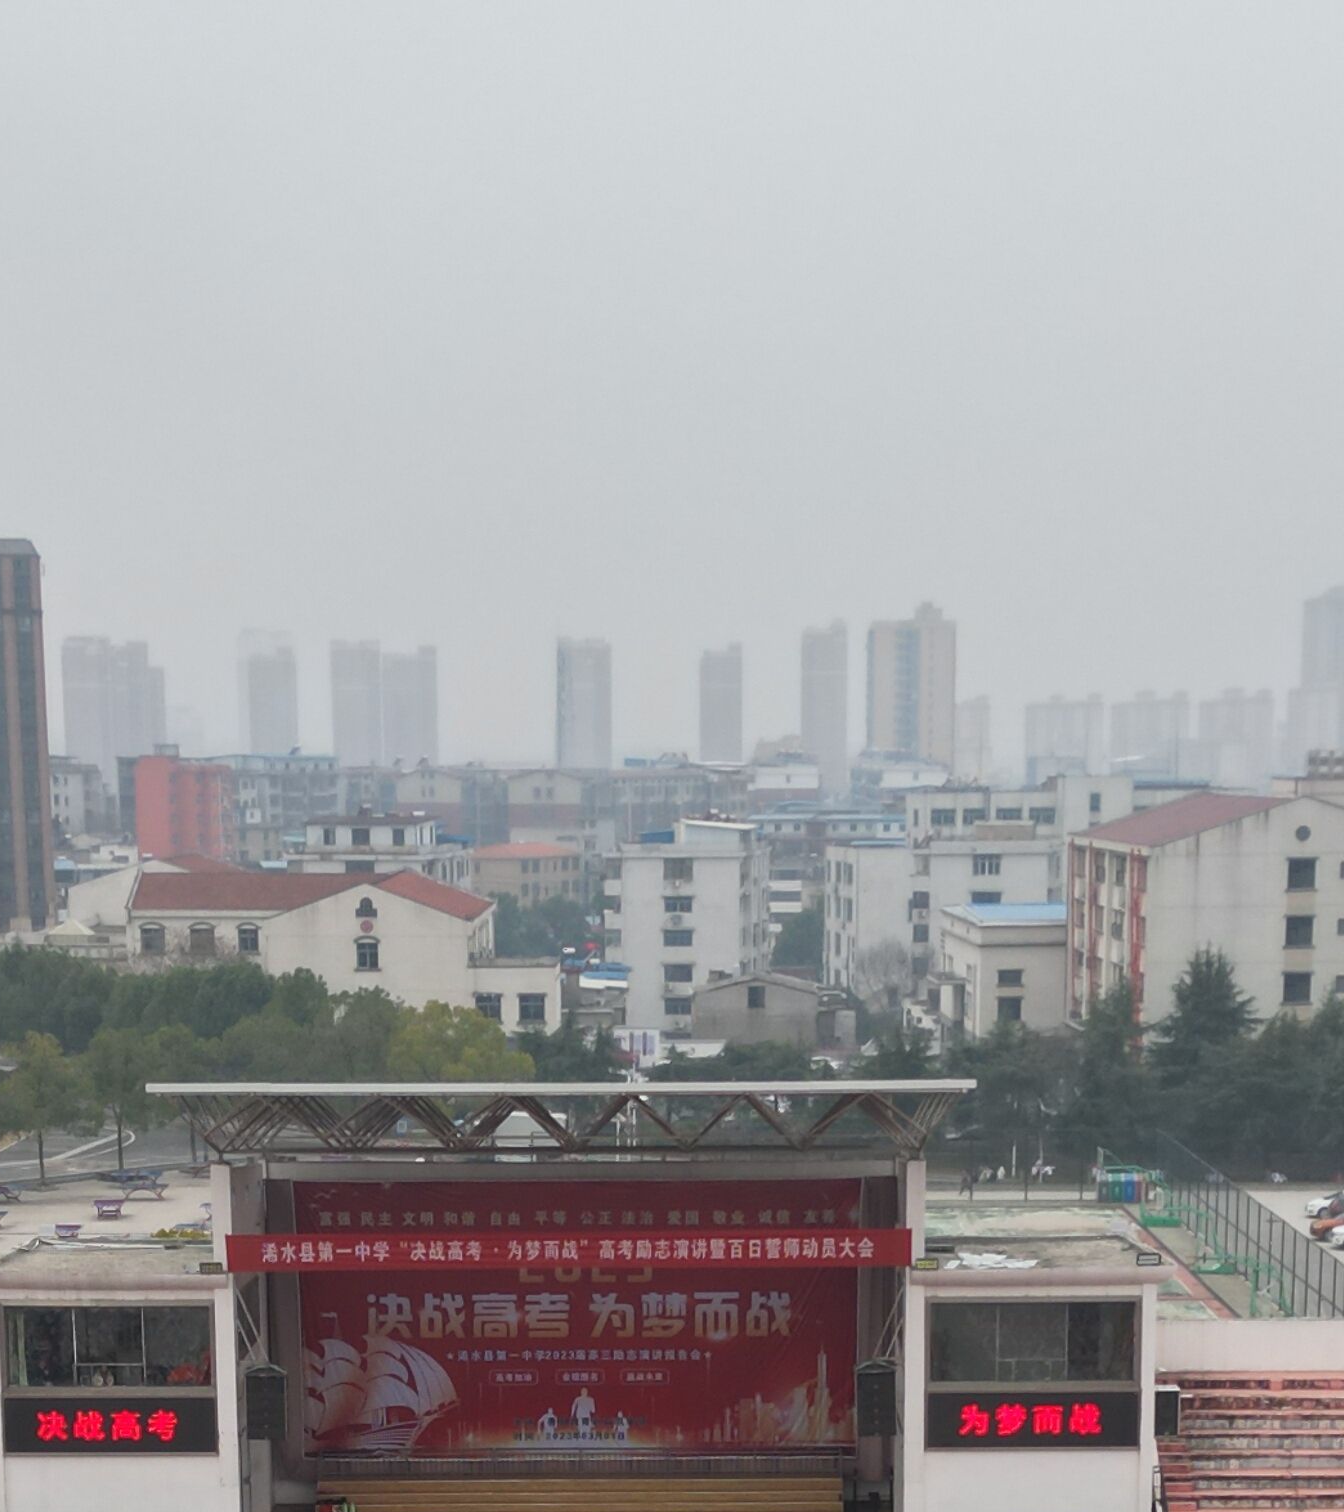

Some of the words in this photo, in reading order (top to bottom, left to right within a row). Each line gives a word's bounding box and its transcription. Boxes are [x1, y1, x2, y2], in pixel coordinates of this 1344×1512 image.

[359, 1211, 392, 1227] 民主
[402, 1211, 434, 1227] 文明
[444, 1211, 476, 1227] 和谐
[490, 1211, 521, 1227] 自由
[535, 1211, 567, 1227] 平等
[580, 1211, 612, 1226] 公正
[260, 1240, 390, 1263] 浠水县第一中学
[599, 1237, 875, 1261] 高考励志演讲暨百日誓师动员大会
[367, 1292, 571, 1339] 决战高考
[588, 1291, 792, 1338] 为梦而战
[35, 1408, 179, 1441] 决战高考
[958, 1403, 1103, 1436] 为梦而战
